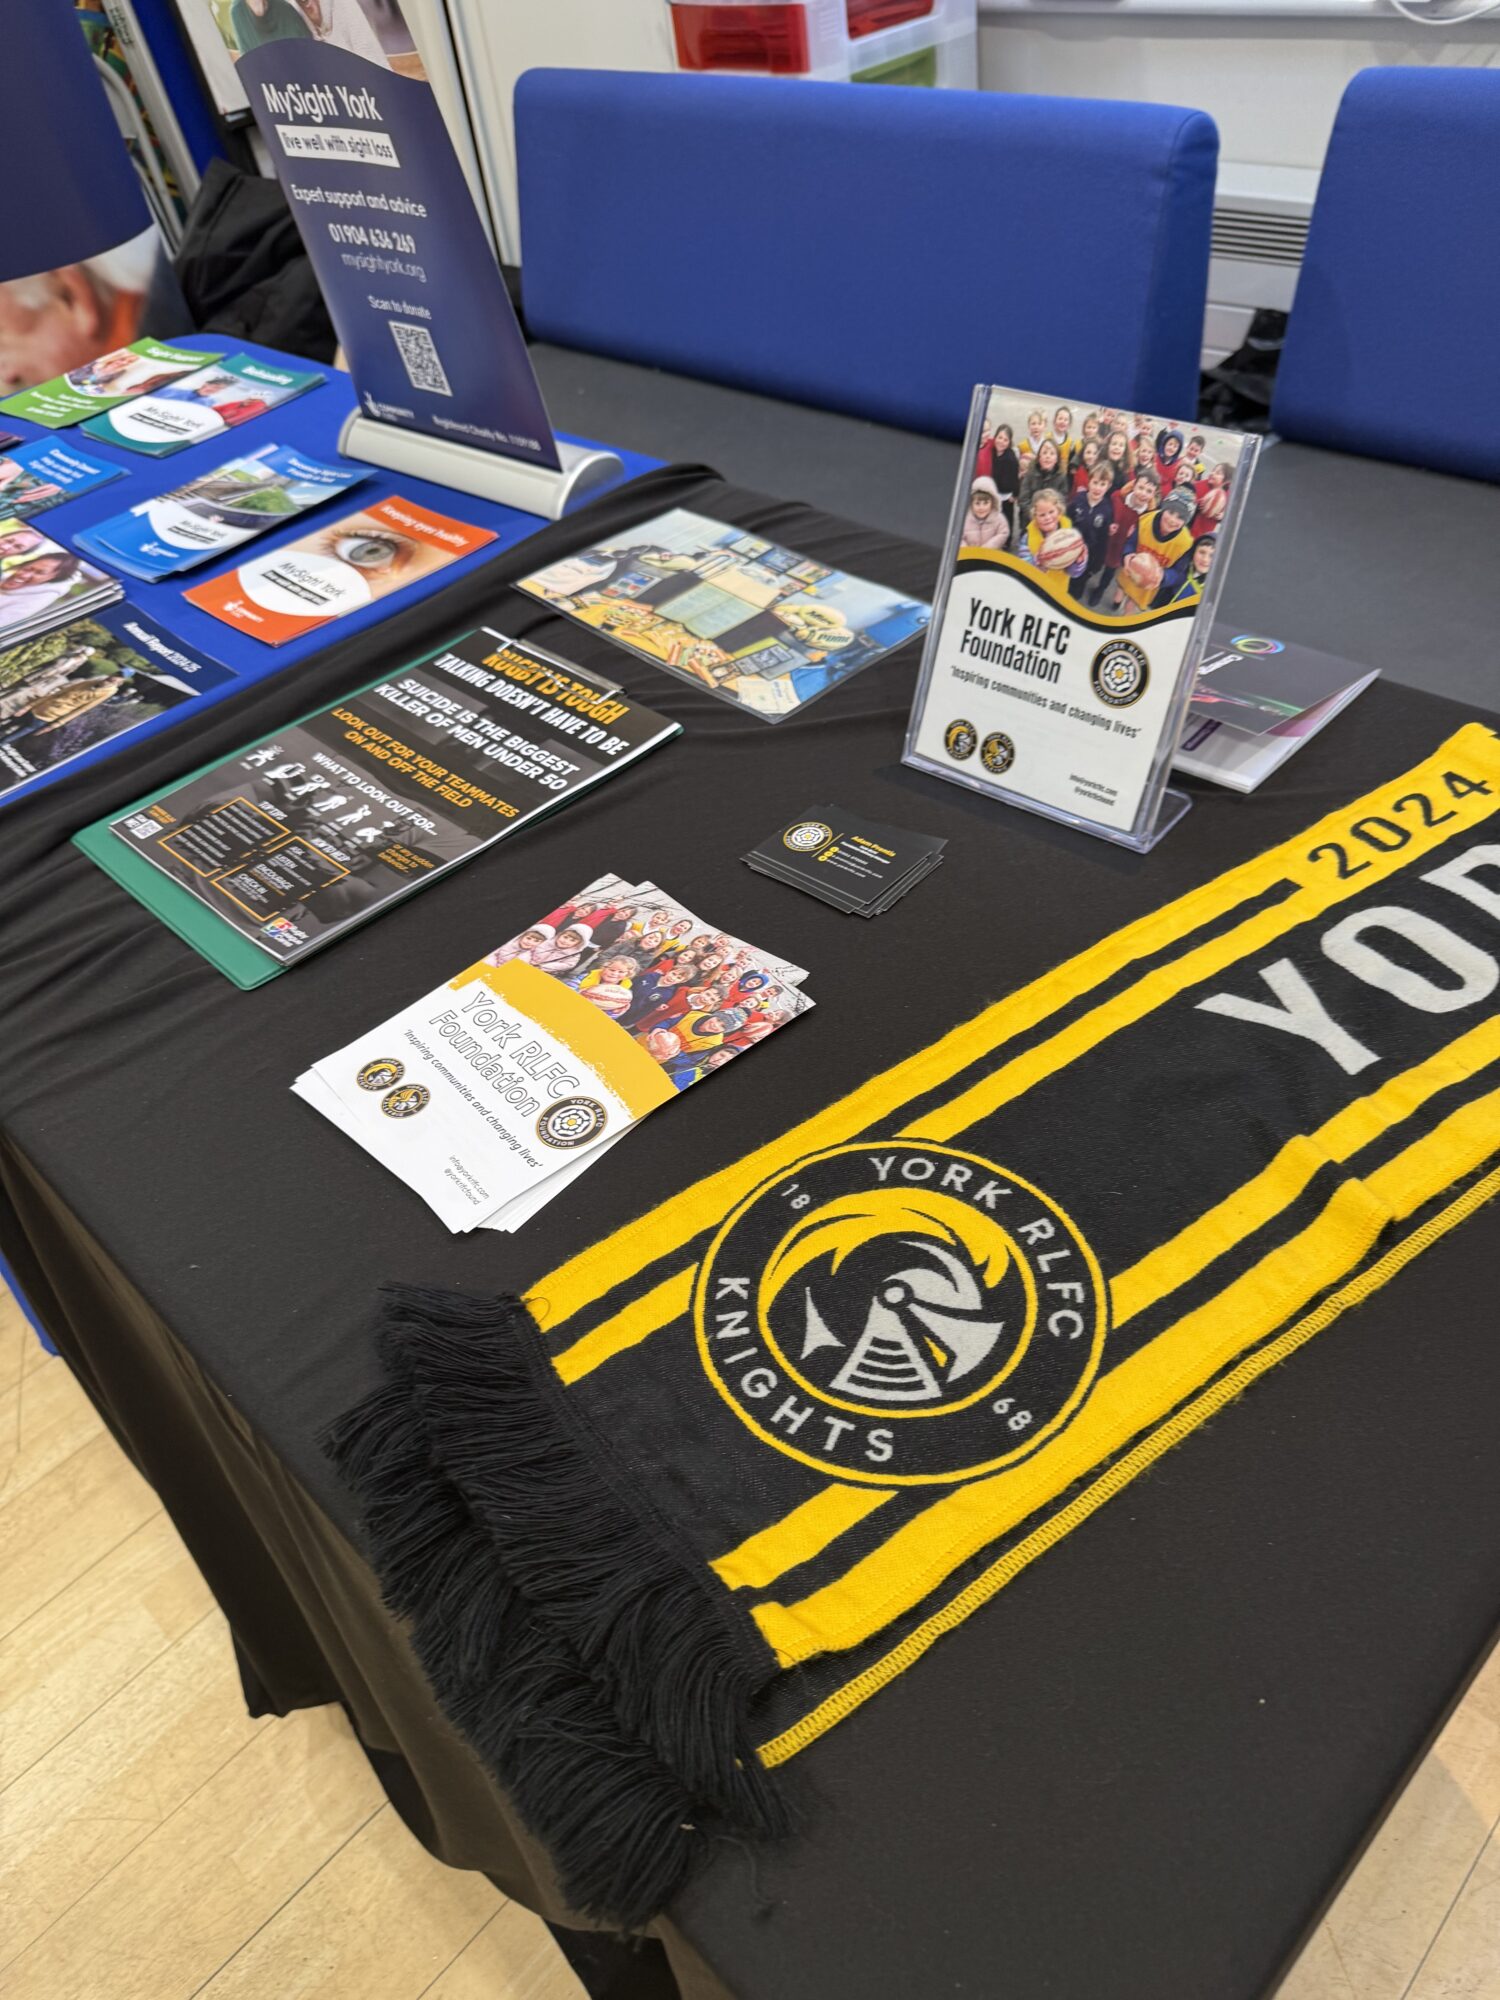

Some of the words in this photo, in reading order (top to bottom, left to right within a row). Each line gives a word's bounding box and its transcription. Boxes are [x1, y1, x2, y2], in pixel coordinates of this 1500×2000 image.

[261, 83, 339, 123] MySight
[335, 86, 383, 121] York
[281, 132, 301, 149] live
[302, 132, 324, 151] well
[325, 135, 348, 152] with
[348, 133, 371, 158] sight
[372, 138, 393, 158] loss
[291, 184, 325, 204] Expert
[325, 190, 366, 208] support
[367, 194, 389, 210] and
[389, 197, 427, 217] advice
[328, 223, 369, 246] 01904
[369, 228, 394, 249] 636
[392, 232, 416, 254] 269
[368, 295, 391, 311] Scan
[403, 302, 432, 319] donate
[380, 505, 417, 527] Keeping
[413, 522, 437, 535] eyes
[433, 529, 470, 547] healthy
[280, 562, 323, 587] MySight
[321, 583, 346, 598] York
[968, 598, 1014, 636] York
[1019, 613, 1070, 654] RLFC
[482, 647, 551, 686] RUGBY
[960, 630, 1061, 683] Foundation
[433, 652, 494, 688] TALKING
[485, 679, 549, 716] DOESN'T
[540, 707, 587, 734] HAVE
[576, 726, 609, 745] TO
[596, 736, 629, 755] BE
[535, 673, 571, 695] IS
[552, 682, 629, 725] TOUGH
[990, 678, 1048, 707] communities
[1049, 699, 1067, 716] and
[1069, 703, 1112, 730] changing
[373, 683, 430, 717] KILLER
[422, 710, 455, 730] OF
[448, 724, 488, 749] MEN
[483, 742, 543, 779] UNDER
[537, 772, 569, 791] 50
[397, 678, 460, 715] SUICIDE
[455, 709, 478, 723] IS
[471, 717, 509, 741] THE
[505, 734, 578, 777] BIGGEST
[332, 707, 367, 730] LOOK
[361, 725, 392, 744] OUT
[387, 741, 416, 759] FOR
[411, 754, 448, 778] YOUR
[445, 772, 517, 818] TEAMMATES
[342, 729, 367, 745] ON
[361, 741, 392, 760] AND
[385, 756, 416, 775] OFF
[410, 770, 439, 788] THE
[435, 783, 473, 808] FIELD
[311, 752, 346, 775] WHAT
[341, 771, 362, 784] TO
[356, 780, 390, 803] LOOK
[383, 798, 413, 817] OUT
[408, 812, 442, 836] FOR...
[1307, 771, 1495, 880] 2024
[237, 872, 260, 889] CHECK
[256, 863, 292, 890] ENCOURAGE
[274, 852, 297, 869] LISTEN
[429, 1010, 541, 1118] Foundation
[461, 991, 522, 1050] York
[510, 1041, 580, 1099] RLFC
[430, 1052, 476, 1103] communities
[472, 1101, 490, 1117] and
[486, 1110, 522, 1152] changing
[570, 1099, 597, 1108] YORK
[595, 1108, 603, 1127] RLFC
[540, 1116, 574, 1146] FOUNDATION
[868, 1155, 1014, 1209] YORK
[1017, 1217, 1086, 1340] RLFC
[780, 1183, 811, 1210] 18
[992, 1397, 1033, 1431] 68
[715, 1276, 895, 1462] KNIGHTS
